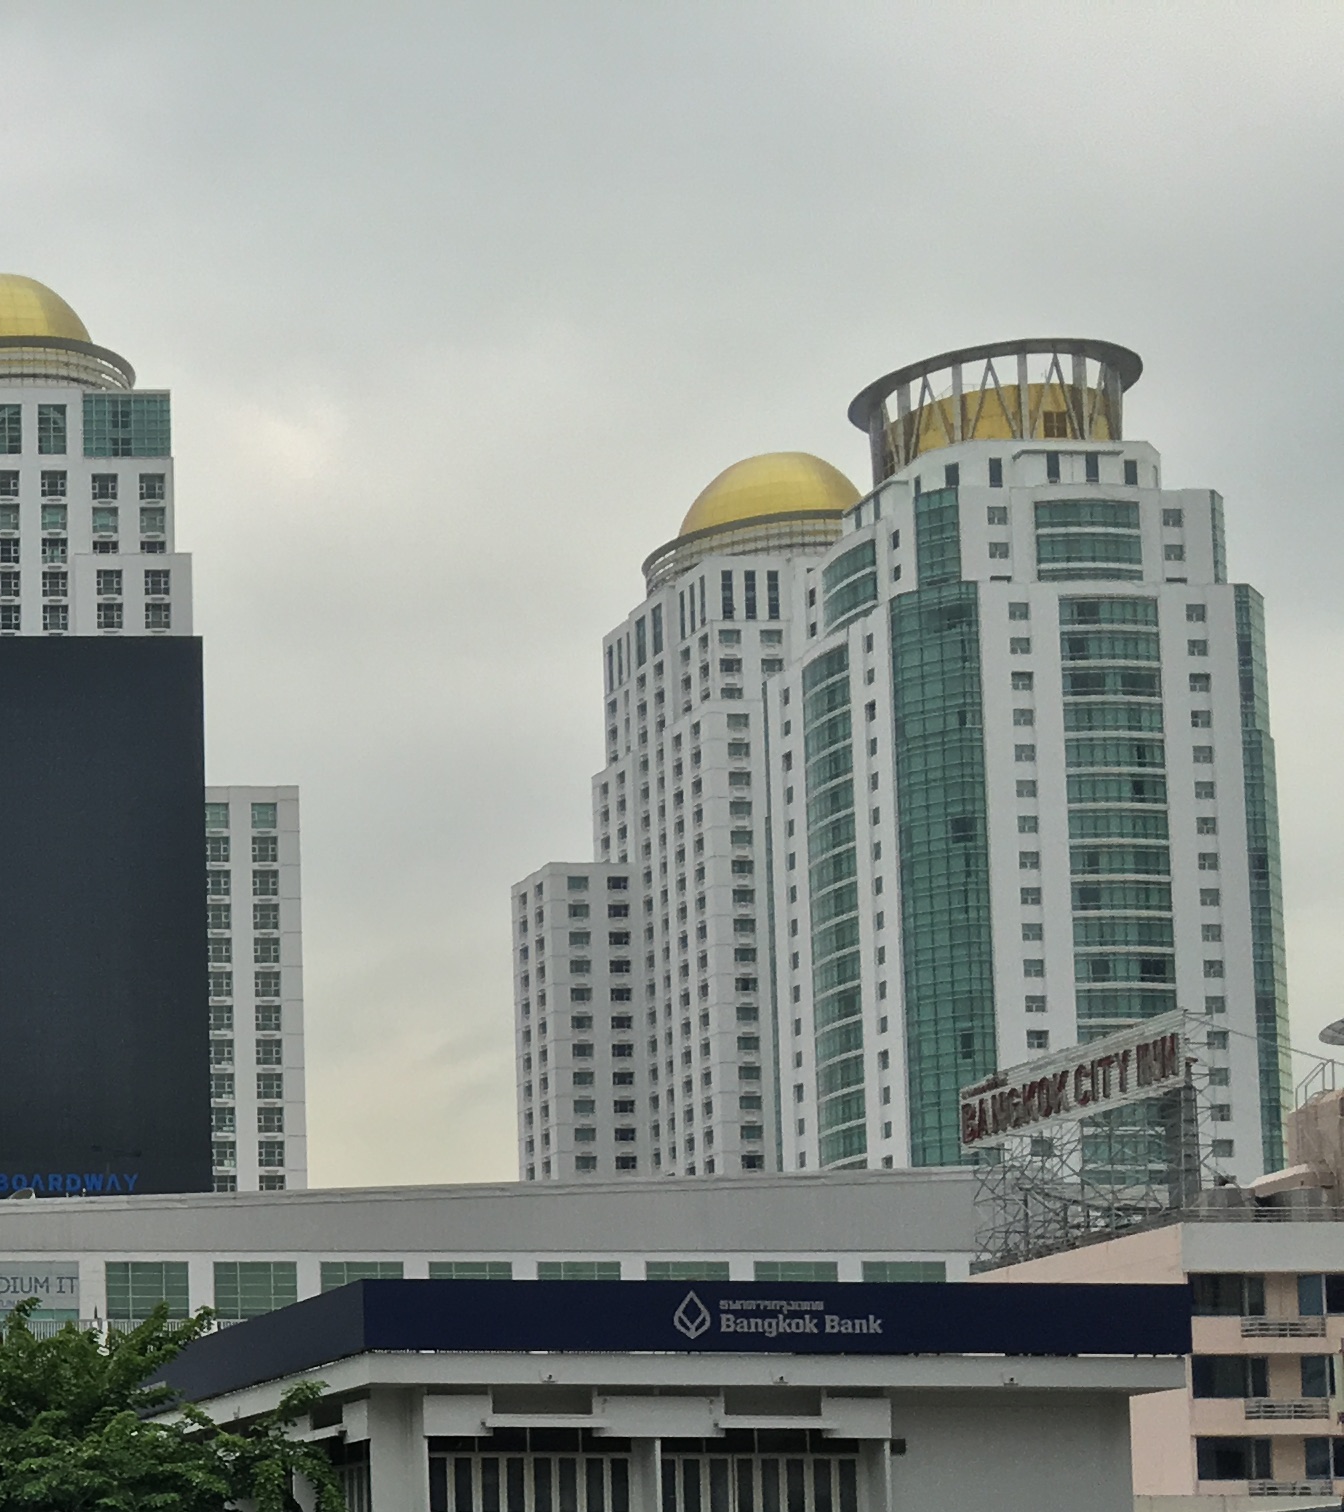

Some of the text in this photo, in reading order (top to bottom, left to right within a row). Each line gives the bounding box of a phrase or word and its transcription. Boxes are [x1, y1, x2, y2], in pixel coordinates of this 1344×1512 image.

[961, 1032, 1180, 1145] BANGKOK CITY INN
[56, 1275, 79, 1294] IT
[720, 1313, 884, 1338] Bangkok Bank
